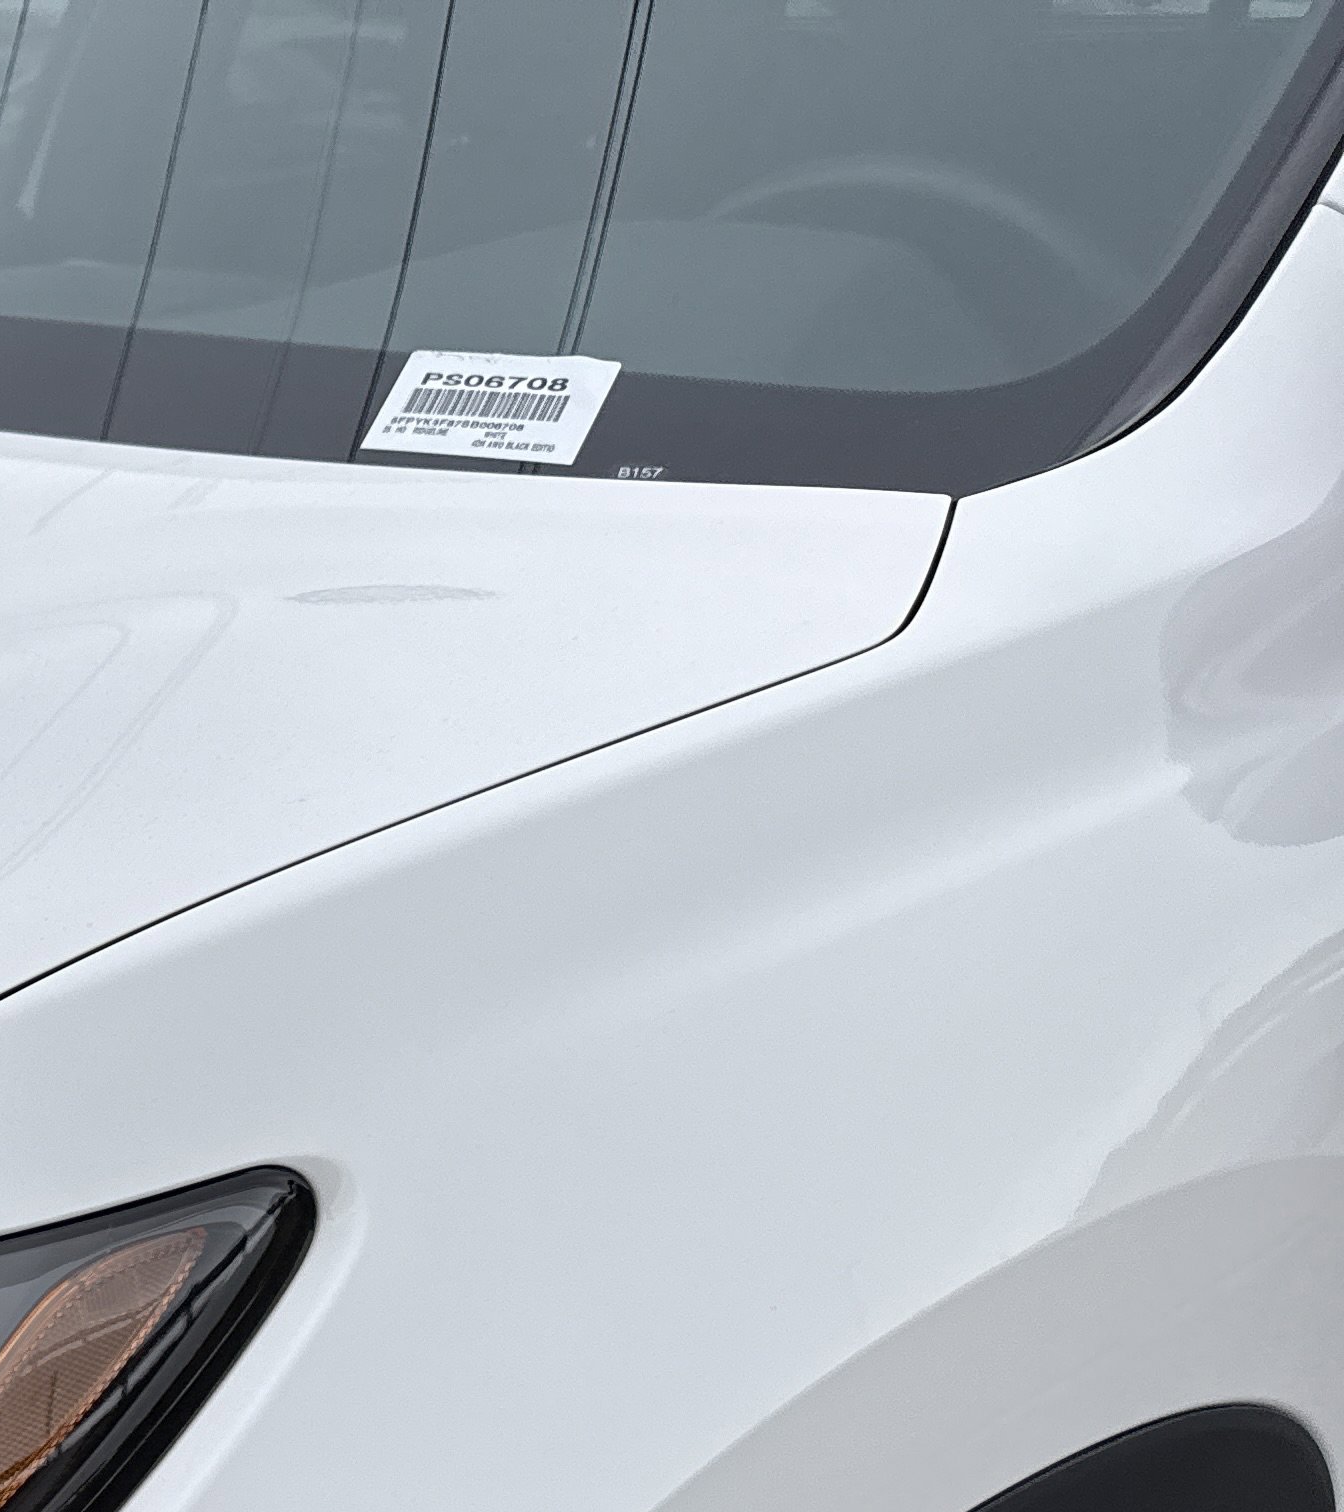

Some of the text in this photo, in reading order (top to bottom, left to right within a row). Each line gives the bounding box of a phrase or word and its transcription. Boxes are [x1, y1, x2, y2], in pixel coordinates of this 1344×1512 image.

[420, 372, 570, 392] PS06708
[505, 441, 531, 451] BLACK
[617, 466, 664, 479] B157
